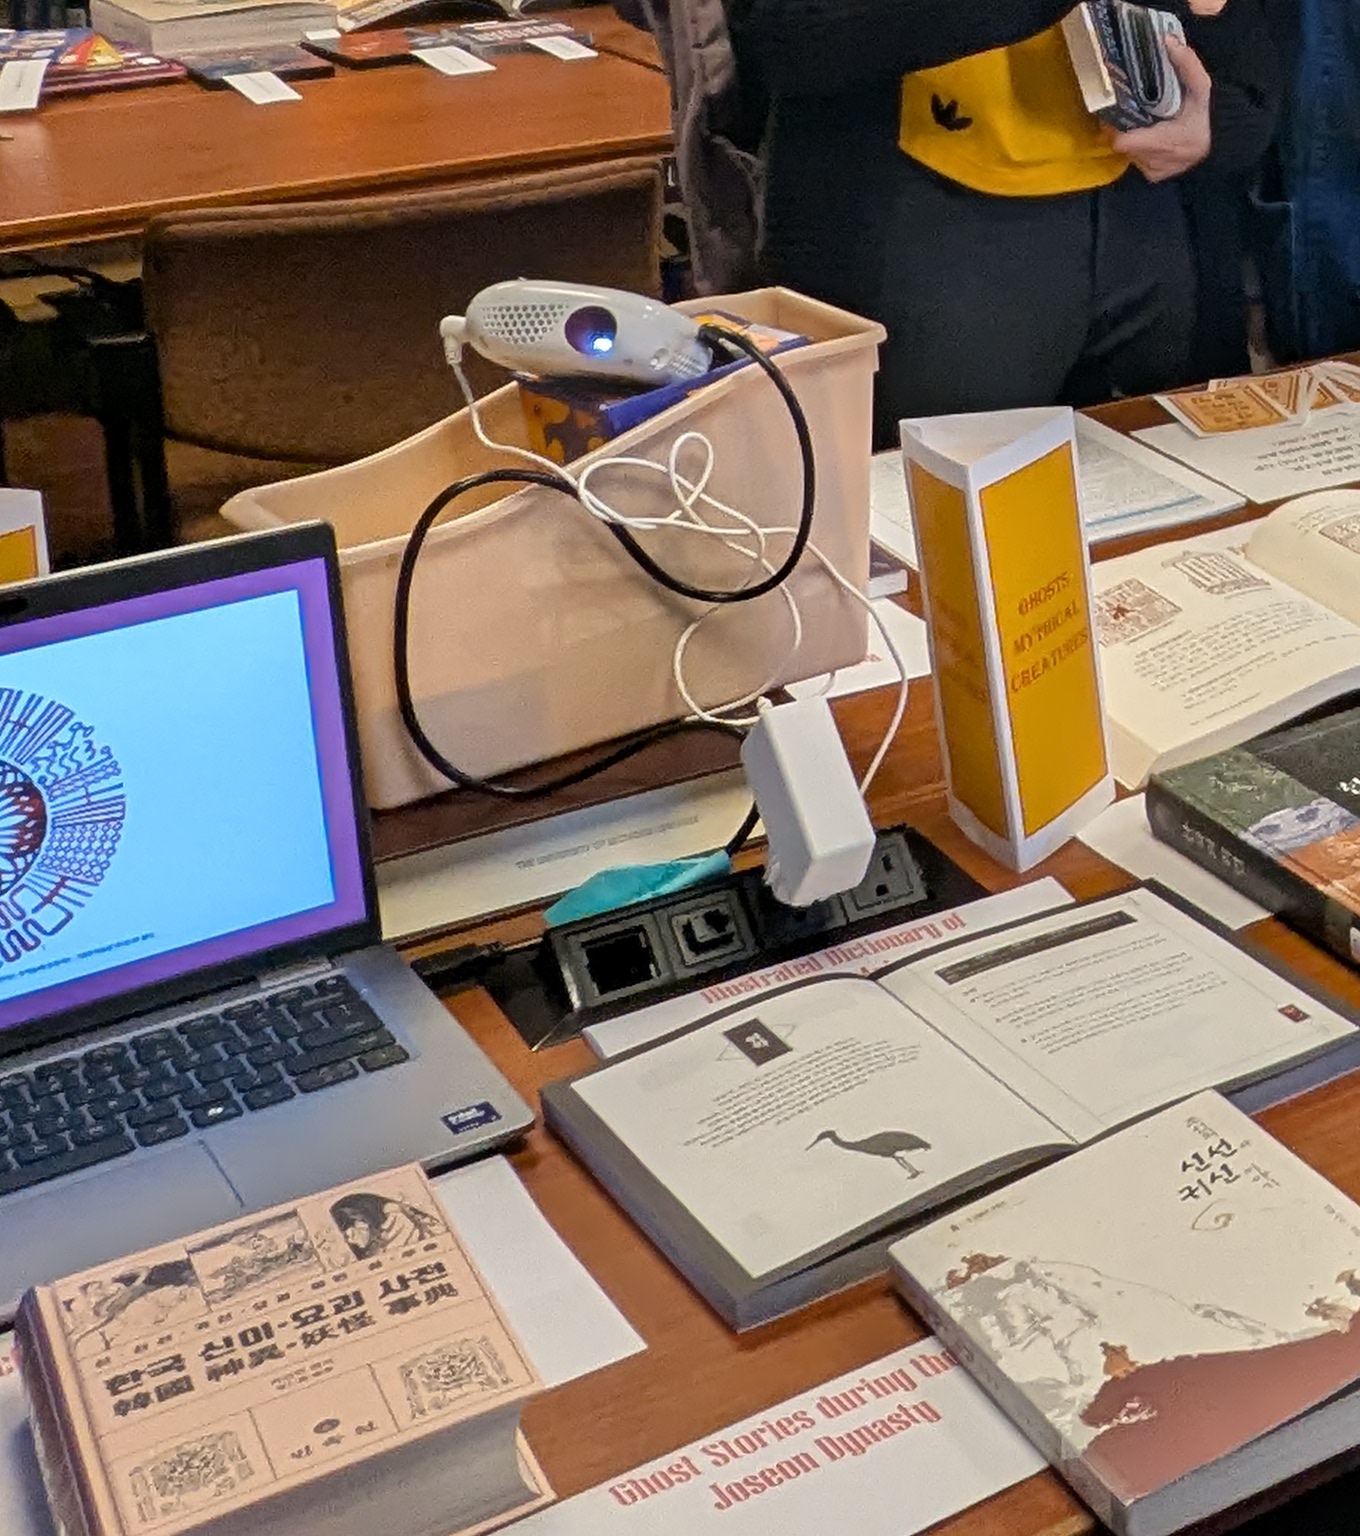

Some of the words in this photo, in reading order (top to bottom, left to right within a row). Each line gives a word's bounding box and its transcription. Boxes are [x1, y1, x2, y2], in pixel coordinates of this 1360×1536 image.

[1017, 570, 1071, 617] GHOSTS
[1011, 626, 1089, 694] CREATURES
[700, 954, 826, 1005] Illustrated
[824, 920, 944, 969] Dictionary
[941, 911, 968, 933] of
[1178, 1163, 1241, 1202] 귀신
[104, 1352, 187, 1397] 한국
[377, 1260, 448, 1300] 사전
[607, 1453, 704, 1508] Ghost
[700, 1406, 818, 1468] Stories
[815, 1366, 920, 1420] during
[707, 1448, 822, 1512] Joseon
[813, 1399, 944, 1463] Dynasty
